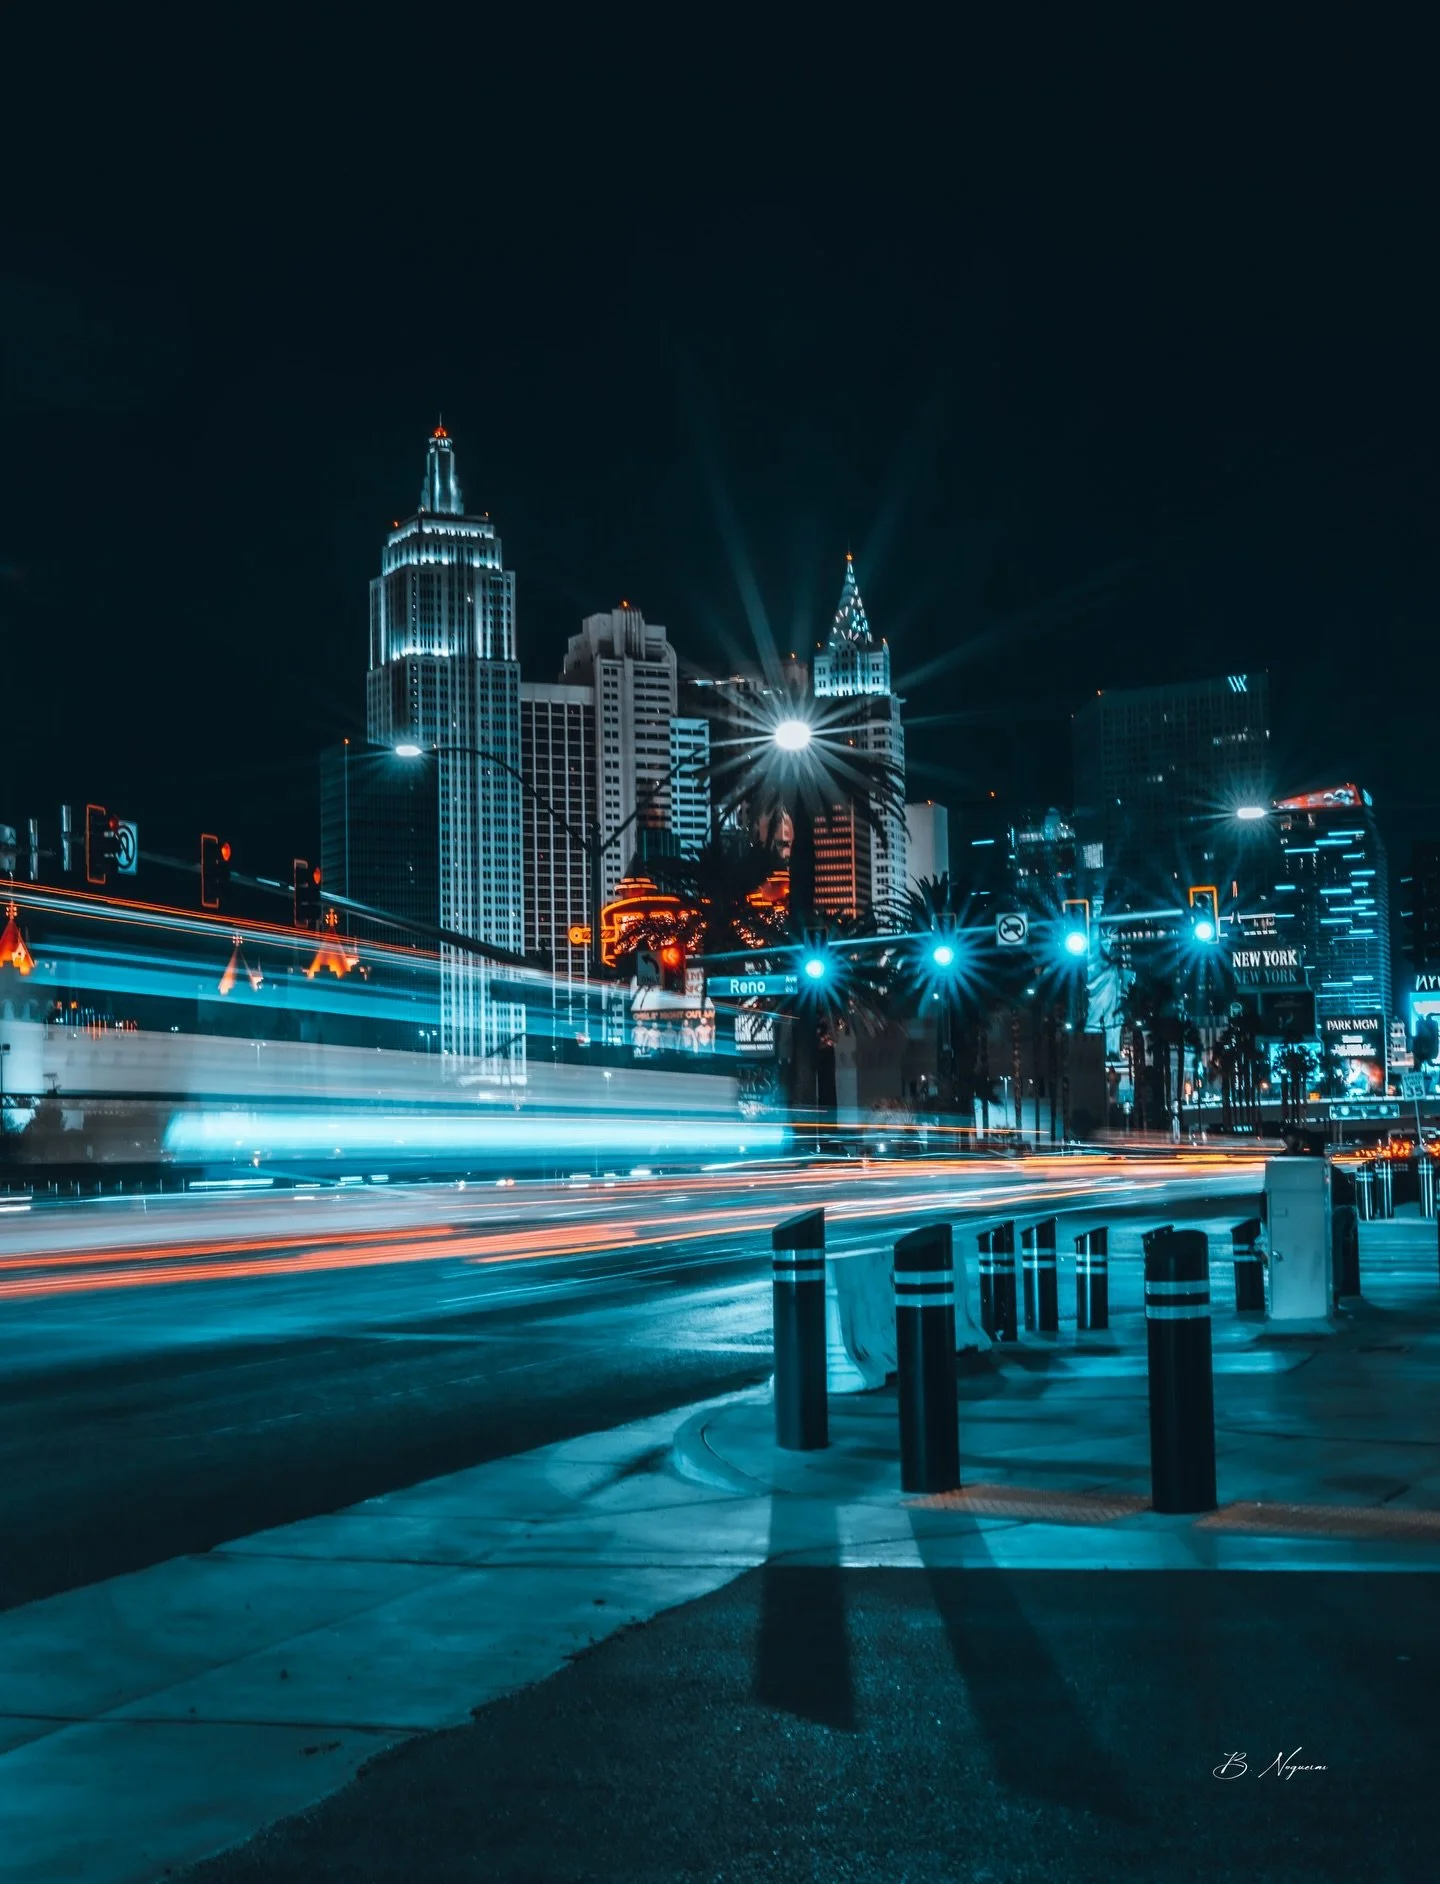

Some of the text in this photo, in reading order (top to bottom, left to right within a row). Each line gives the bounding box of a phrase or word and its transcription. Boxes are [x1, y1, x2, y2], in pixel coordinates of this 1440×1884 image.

[1232, 949, 1298, 968] NEW YORK
[1264, 968, 1297, 984] YORK
[730, 979, 766, 994] Reno
[1327, 1019, 1378, 1031] PARK MGM
[1406, 1085, 1424, 1098] 35
